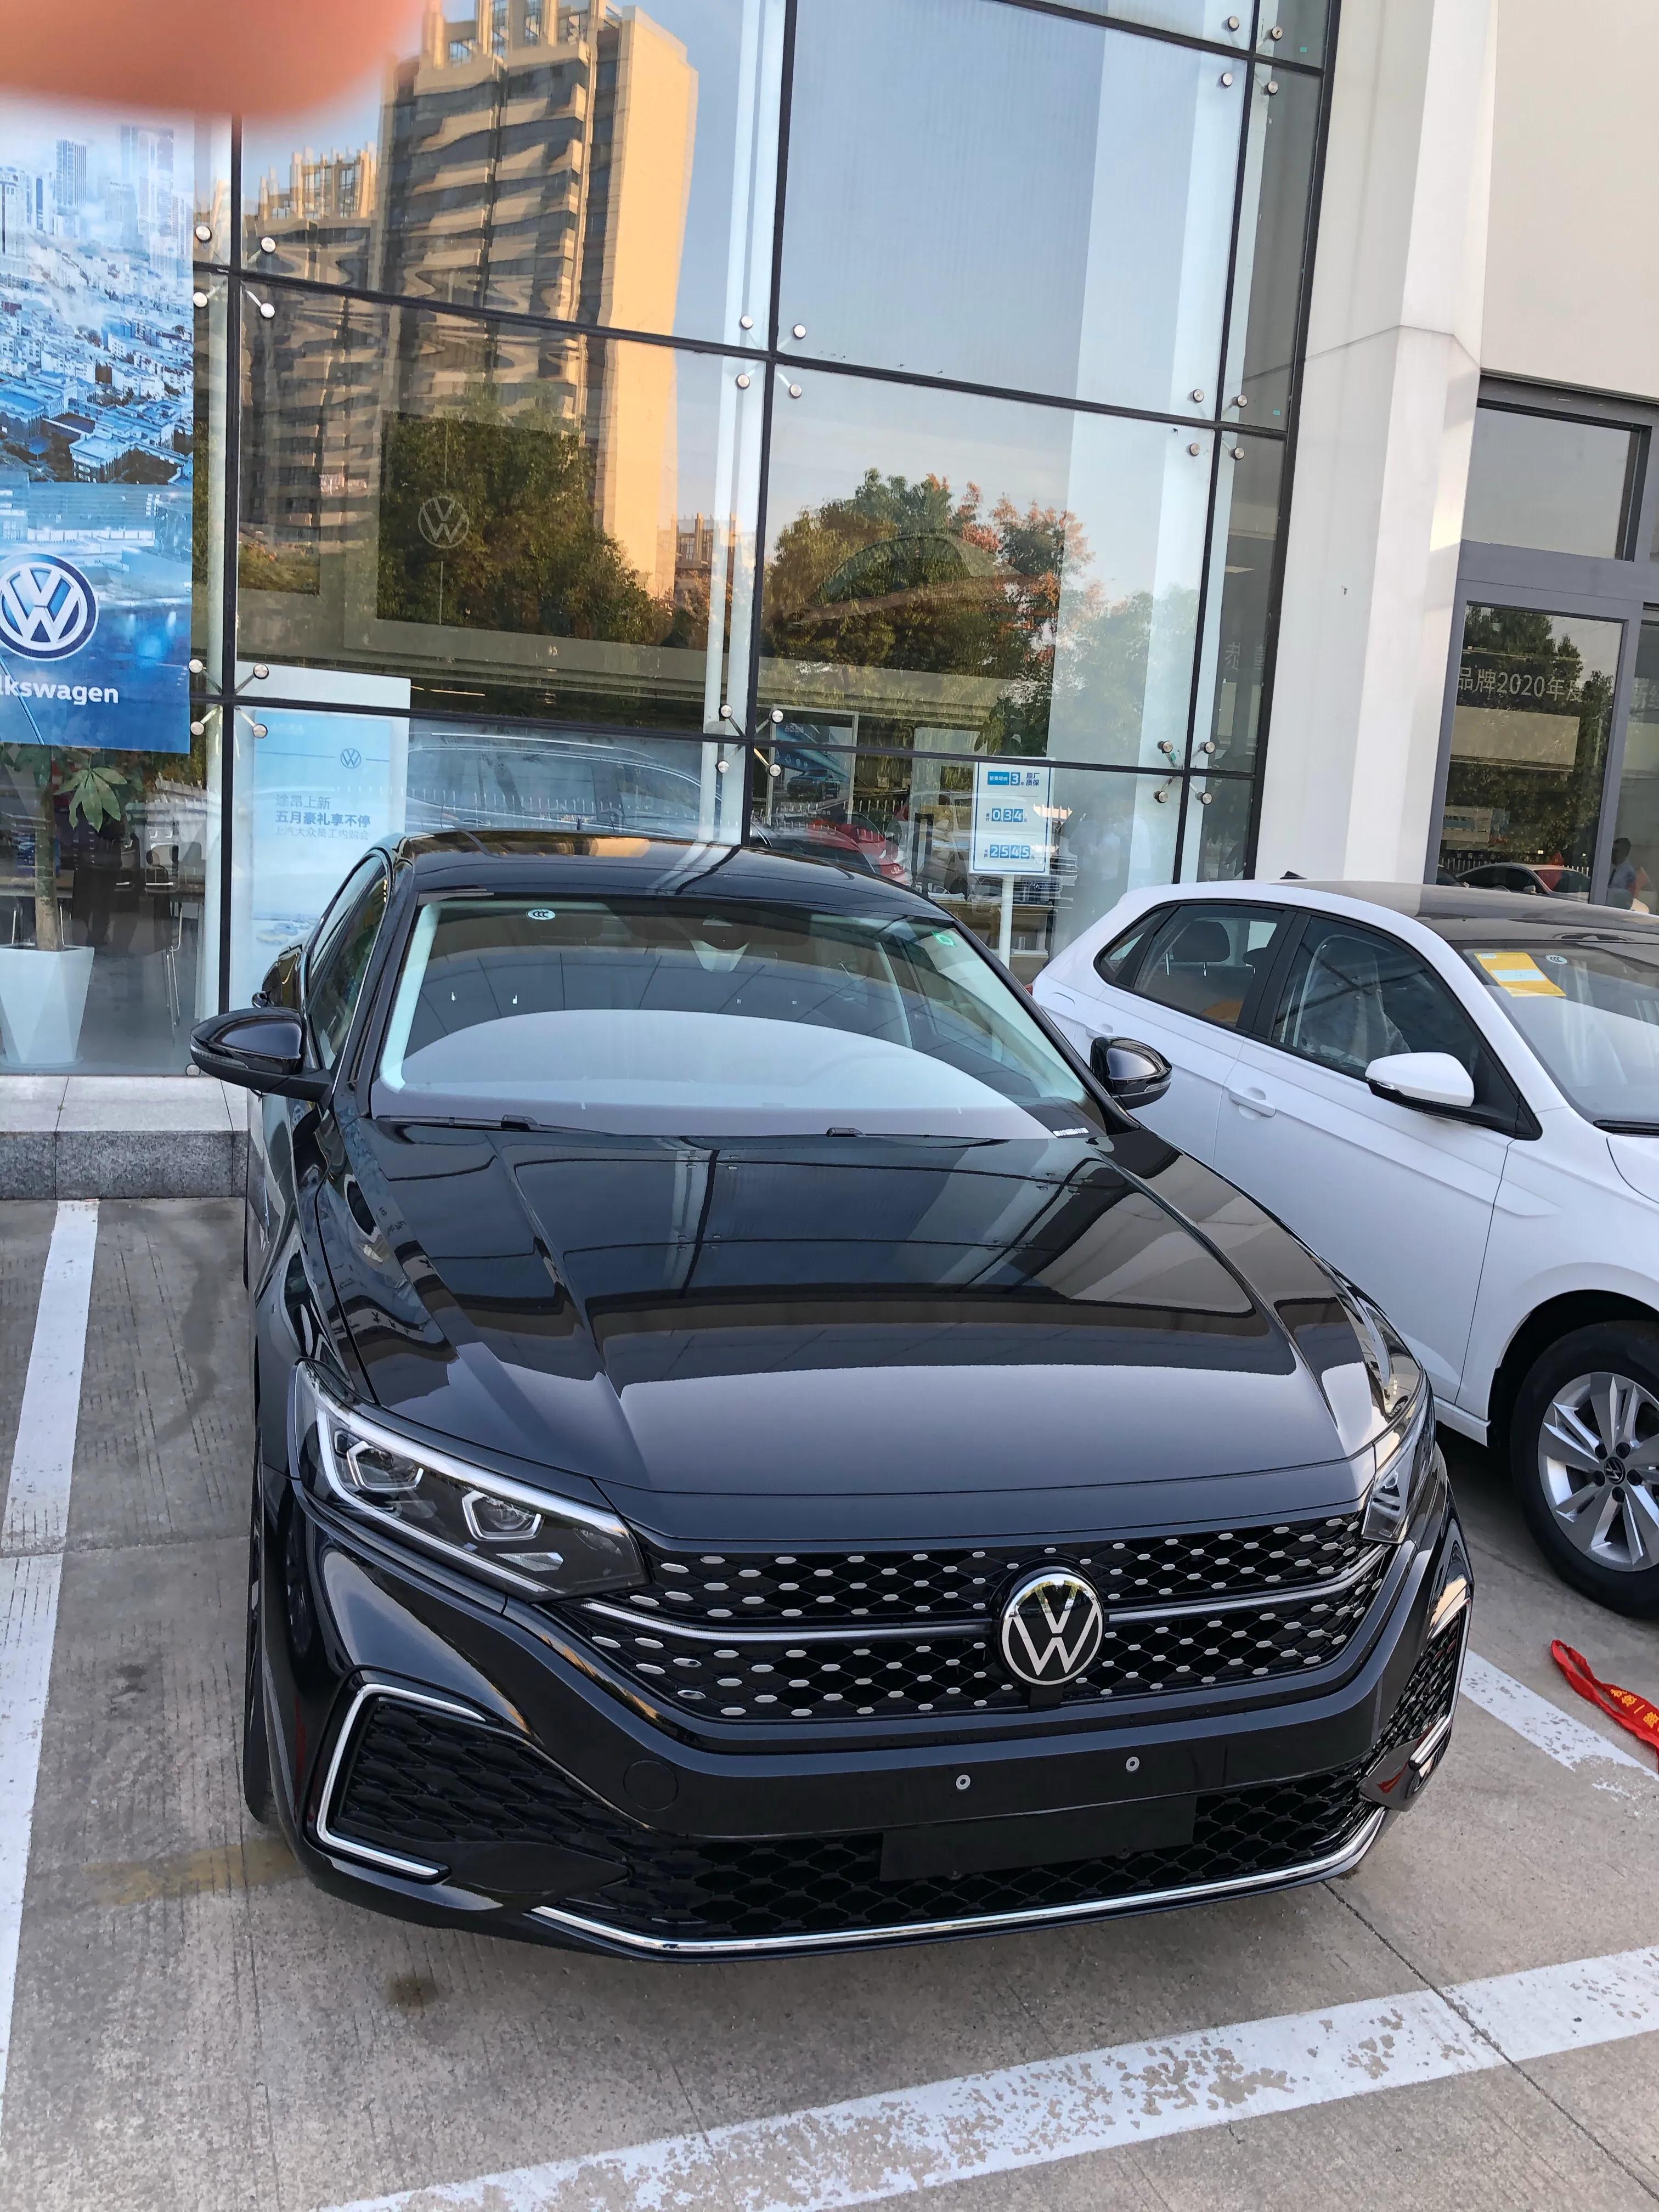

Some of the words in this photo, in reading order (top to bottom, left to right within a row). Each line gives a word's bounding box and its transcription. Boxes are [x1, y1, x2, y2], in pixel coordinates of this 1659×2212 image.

[1011, 773, 1019, 785] 3
[275, 810, 371, 828] 五月豪礼享不停
[991, 846, 1029, 858] 2545
[1006, 1579, 1101, 1680] VW
